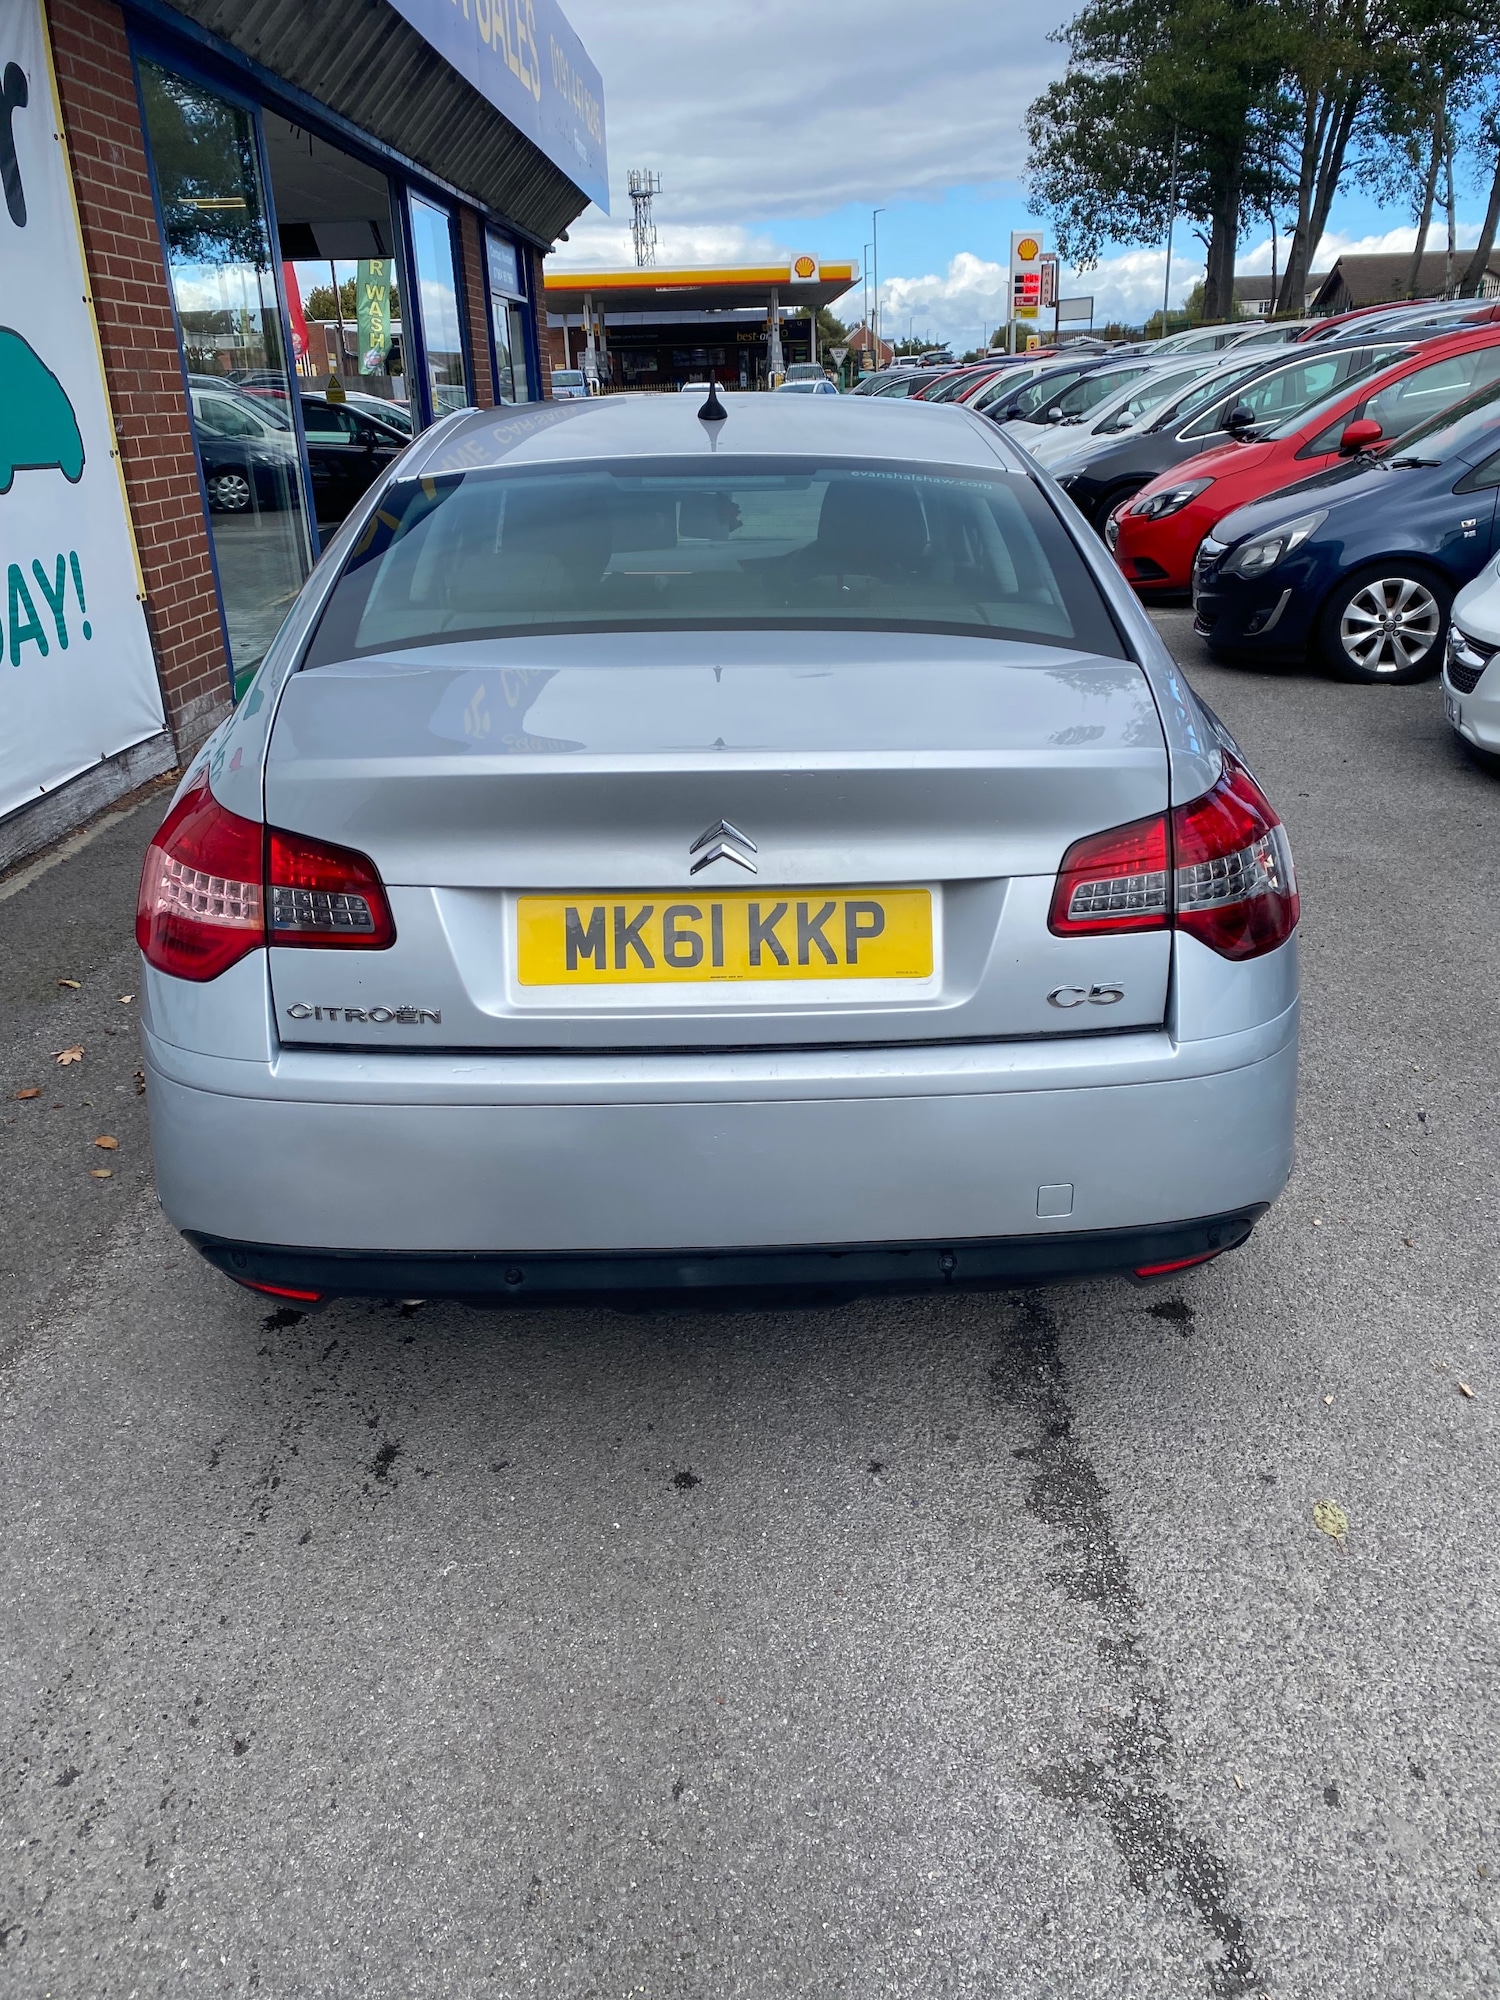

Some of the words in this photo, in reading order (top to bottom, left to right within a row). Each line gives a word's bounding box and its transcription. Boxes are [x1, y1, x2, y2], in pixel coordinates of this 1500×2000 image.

[369, 259, 383, 276] R
[365, 284, 385, 347] WASH
[851, 470, 992, 490] evanshalshaw.com
[0, 550, 92, 668] AY!
[565, 904, 724, 971] MK61
[748, 901, 885, 966] KKP
[1047, 982, 1125, 1008] C5
[286, 1002, 442, 1025] CITROËN
